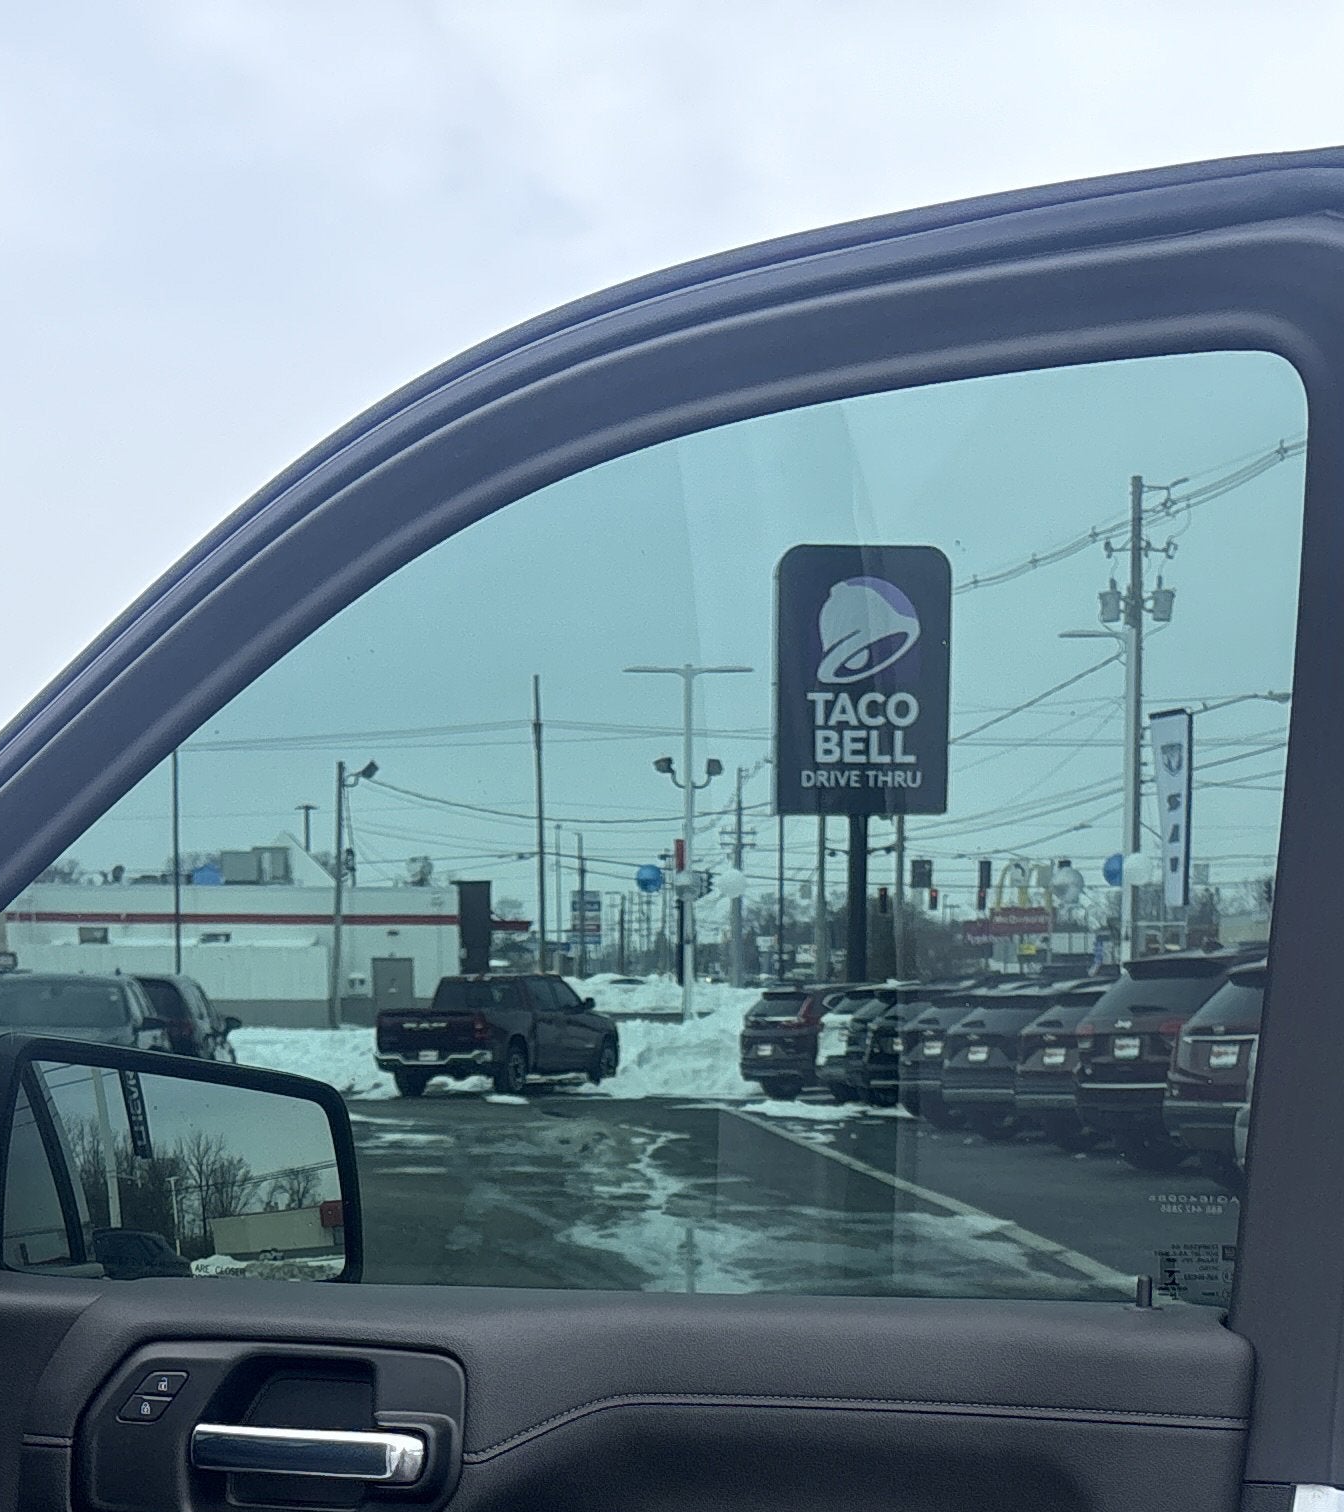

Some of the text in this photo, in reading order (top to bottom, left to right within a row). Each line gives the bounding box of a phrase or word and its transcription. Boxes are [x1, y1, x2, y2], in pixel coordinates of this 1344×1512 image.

[806, 692, 920, 727] TACO
[813, 730, 917, 764] BELL
[801, 770, 923, 788] DRIVE THRU
[195, 1264, 210, 1273] ARE
[215, 1266, 246, 1277] CLOSER
